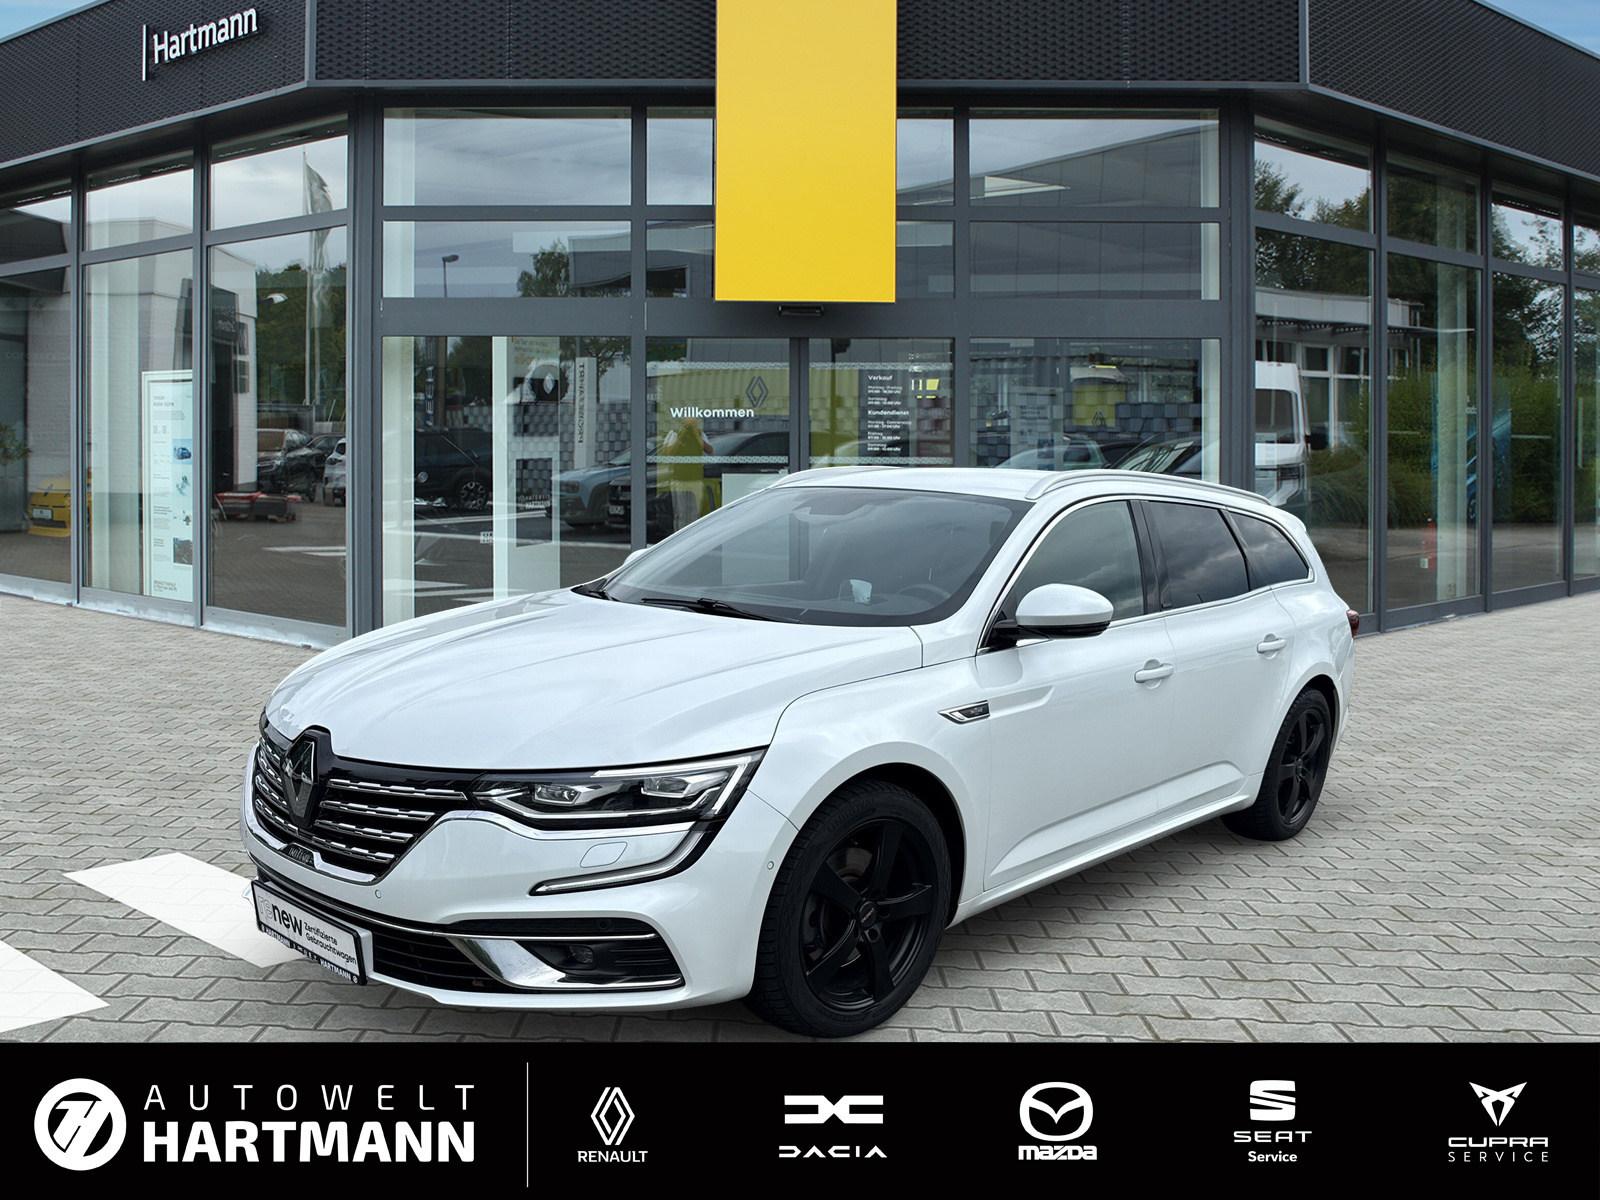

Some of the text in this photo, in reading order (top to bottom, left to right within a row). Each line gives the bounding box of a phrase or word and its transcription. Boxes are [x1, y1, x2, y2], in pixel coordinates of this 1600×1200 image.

[153, 8, 257, 64] Hartmann
[670, 407, 755, 418] Willkommen
[306, 933, 357, 965] Gebrauchtwagen
